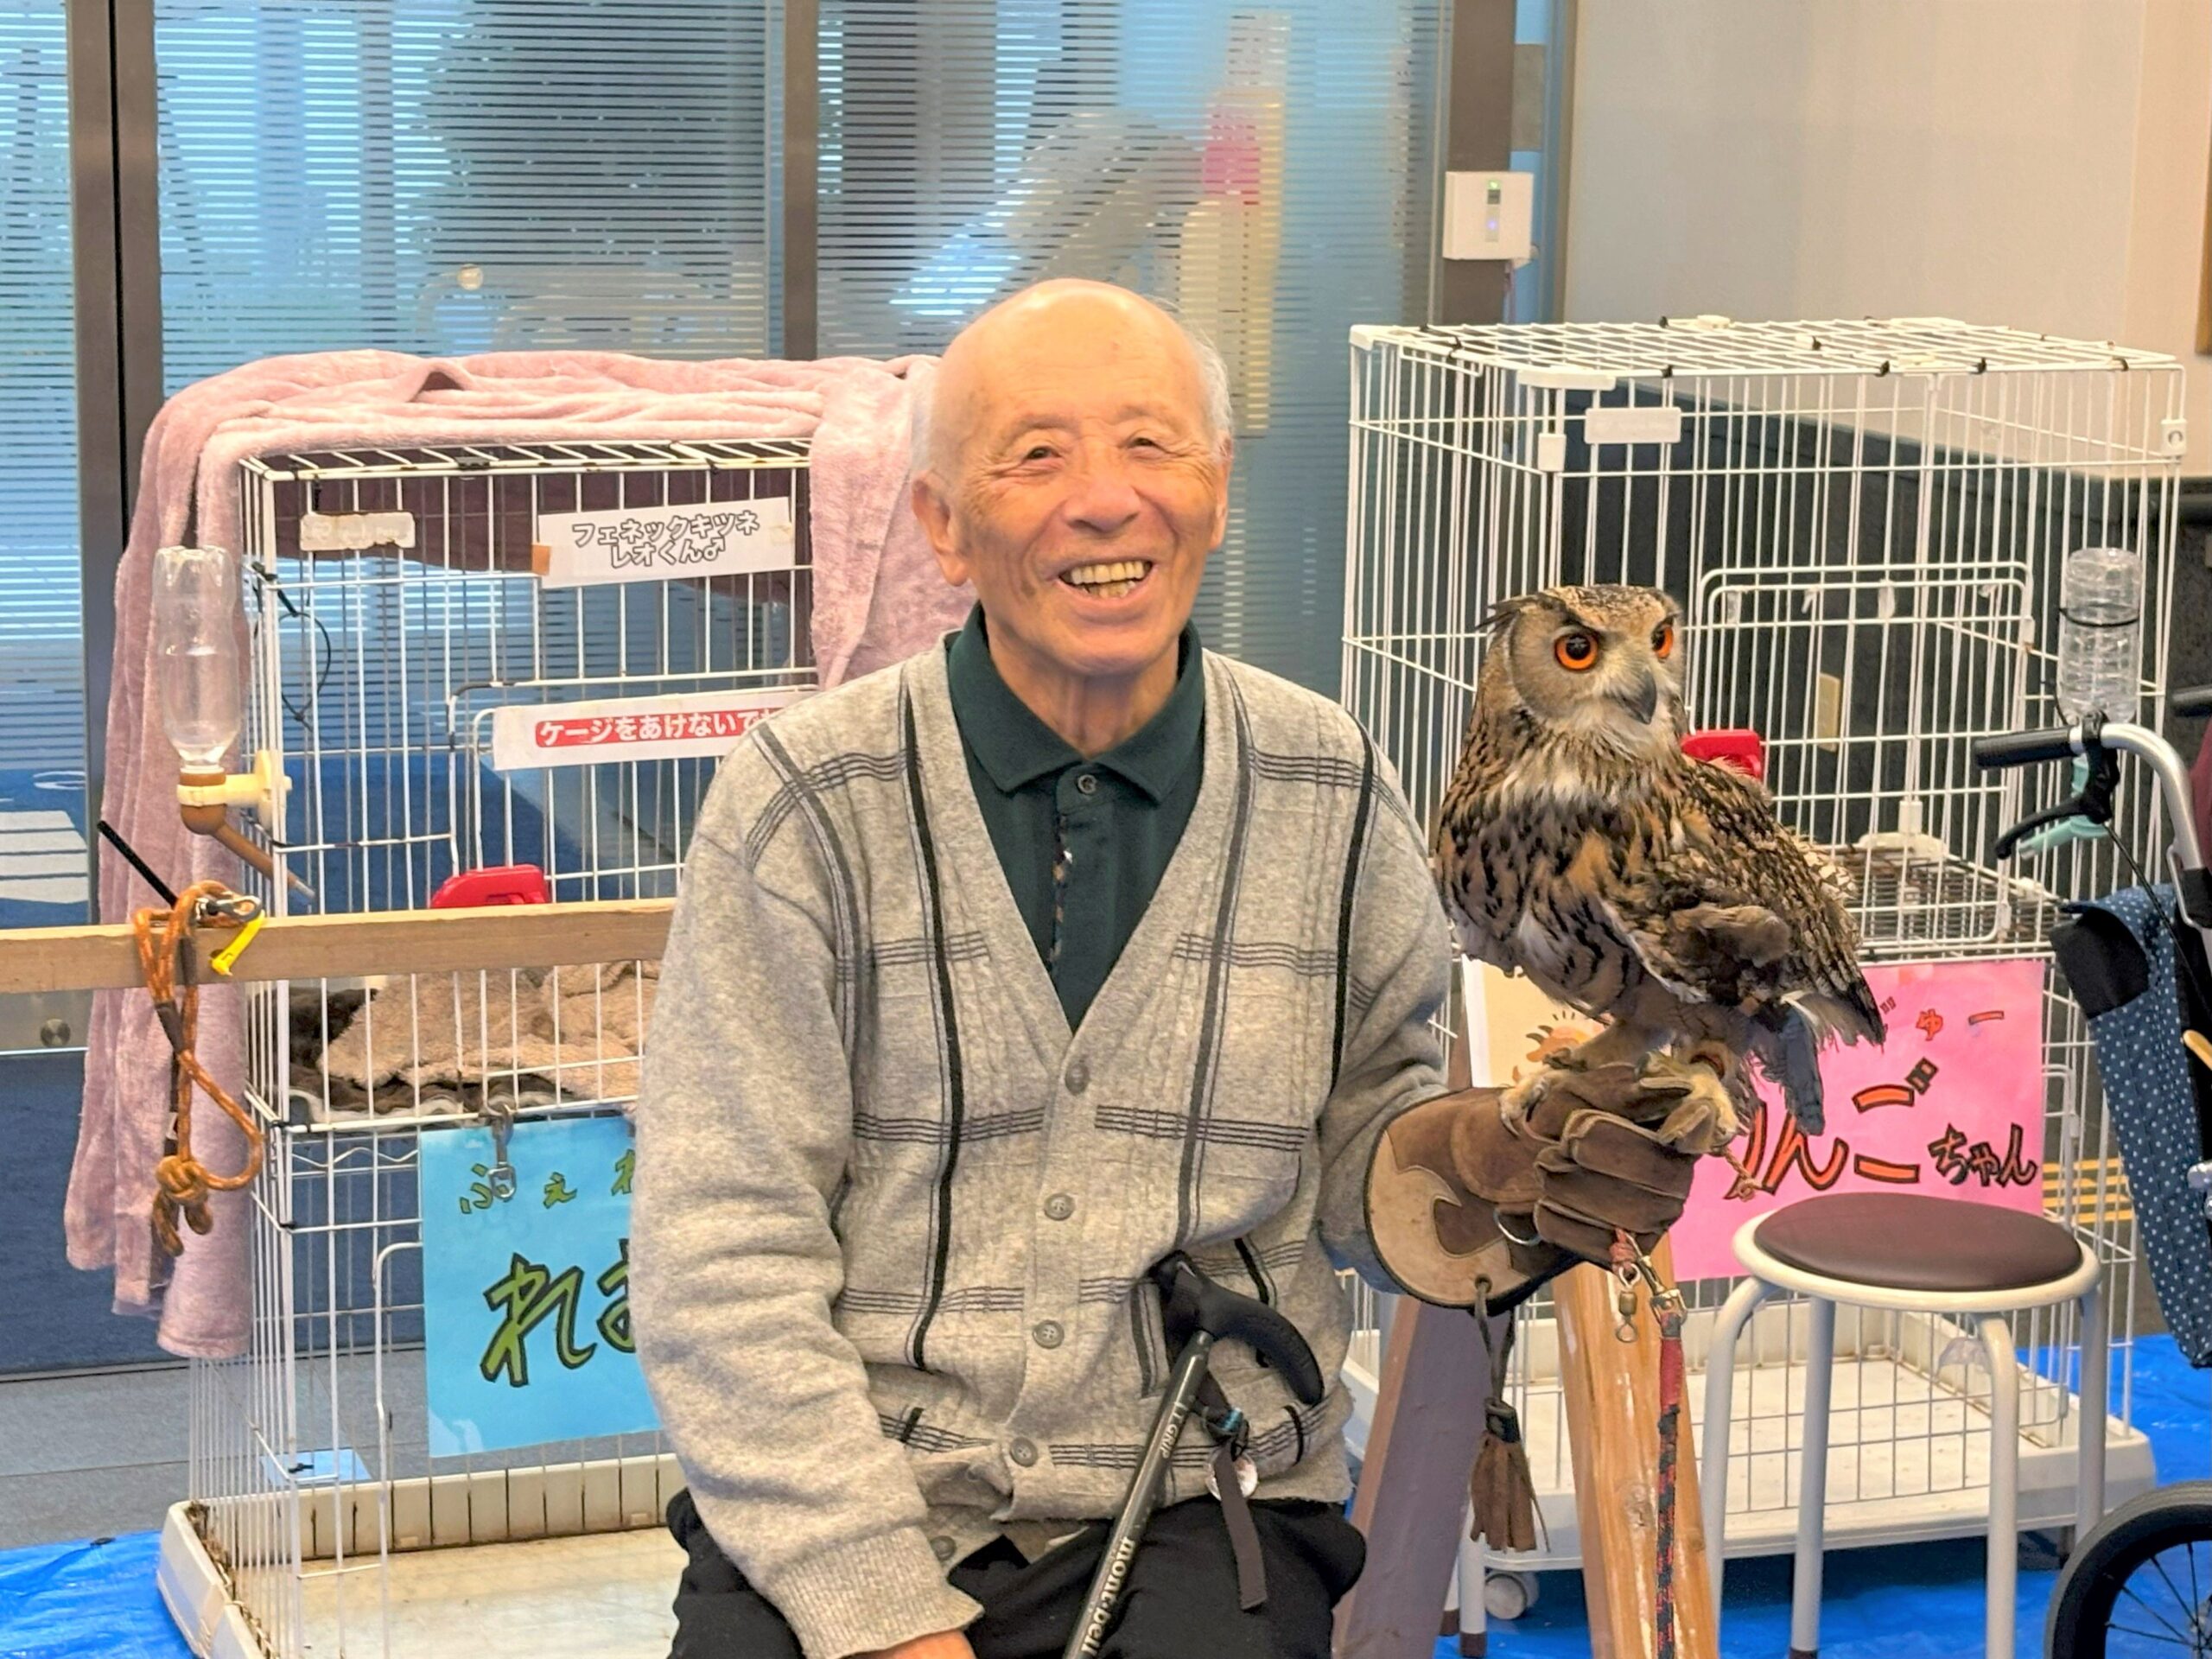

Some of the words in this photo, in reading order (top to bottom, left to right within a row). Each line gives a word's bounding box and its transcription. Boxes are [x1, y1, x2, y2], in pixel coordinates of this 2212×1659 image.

[572, 510, 760, 548] フェネックキツネ
[1159, 1423, 1179, 1459] GRIP
